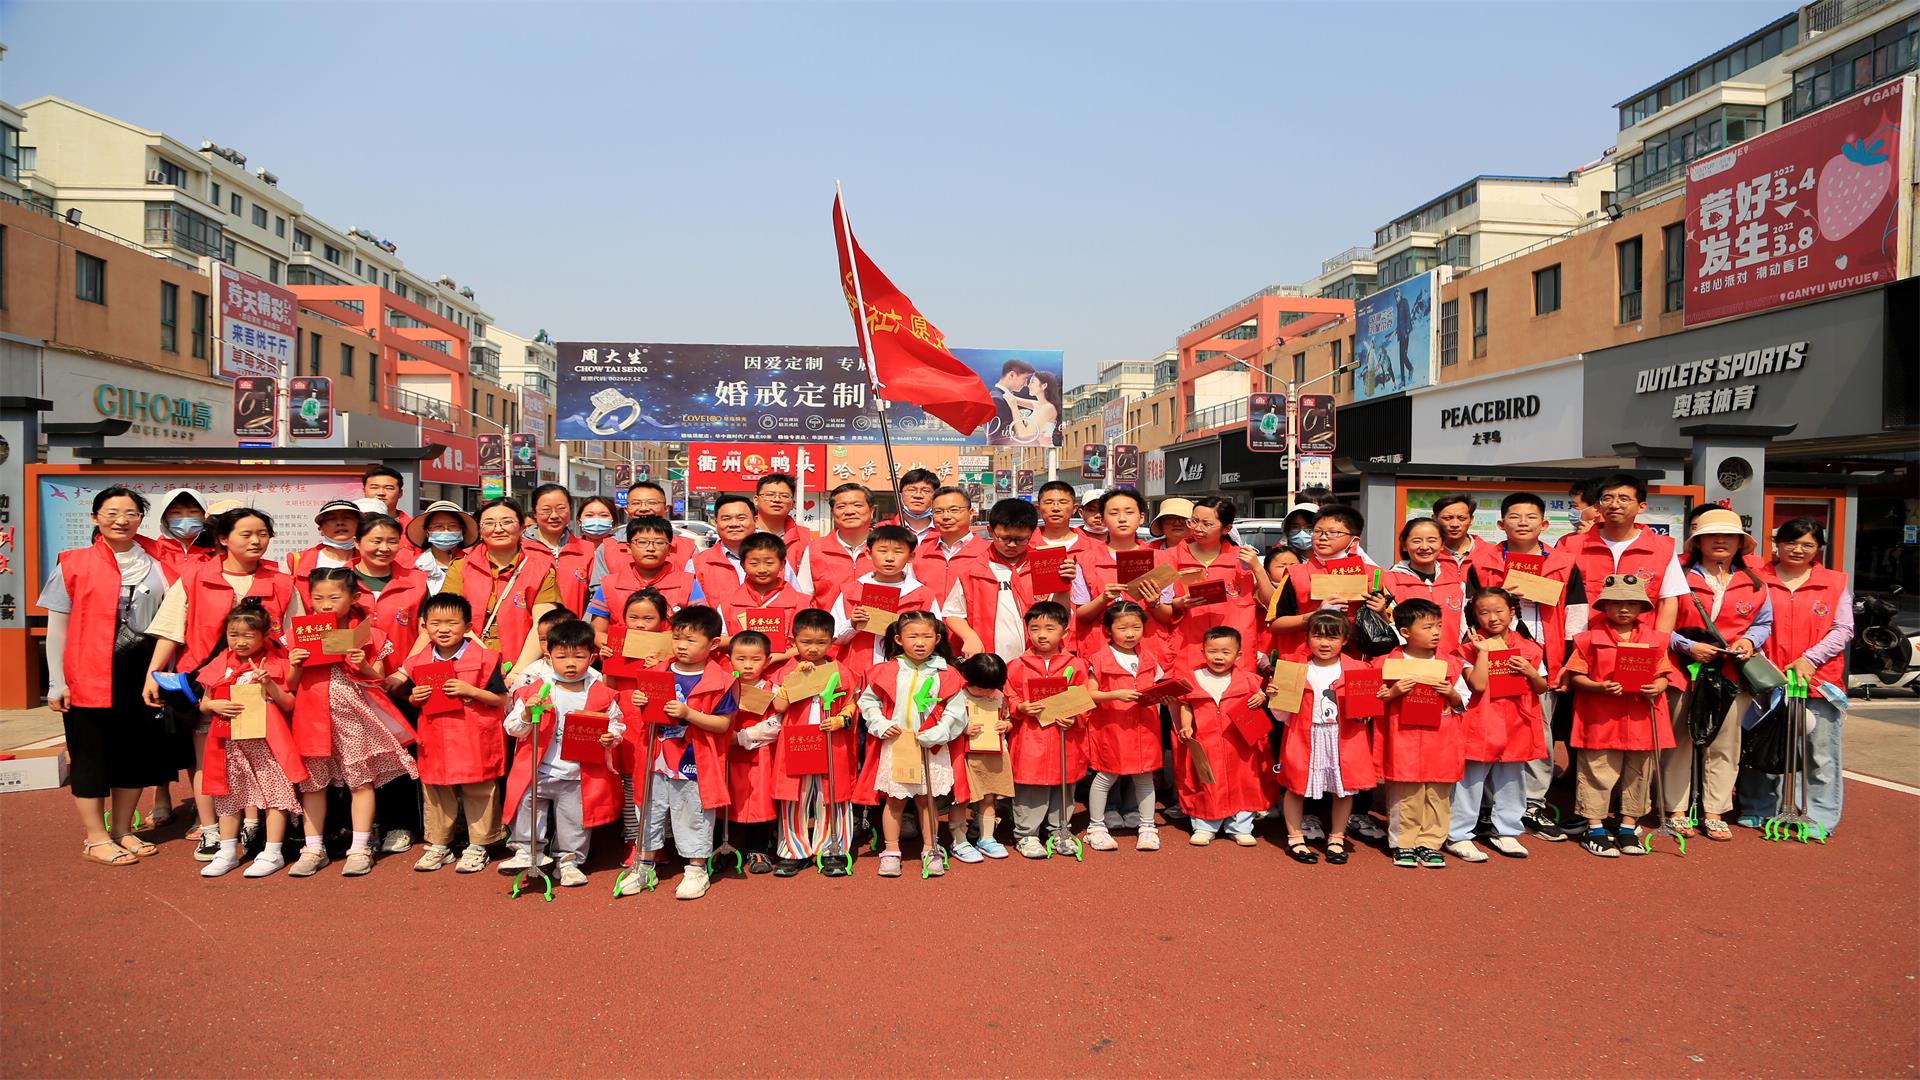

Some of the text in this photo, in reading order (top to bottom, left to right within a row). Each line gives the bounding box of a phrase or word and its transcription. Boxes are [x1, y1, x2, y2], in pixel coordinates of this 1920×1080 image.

[1774, 165, 1795, 178] 2022
[1774, 168, 1816, 201] 3.4
[1773, 222, 1794, 233] 2022
[1773, 226, 1814, 257] 3.8
[1699, 221, 1770, 279] 发生
[1700, 254, 1809, 294] 甜心派对 潮动春日
[1786, 272, 1873, 301] GANYU WUYUE
[232, 323, 288, 356] 来吾悦千斤
[232, 346, 281, 375] 草莓免费
[574, 365, 648, 373] CHOW TAI SENG
[580, 348, 642, 365] 周大生
[744, 356, 824, 371] 因爱定制
[1635, 341, 1807, 394] OUTLETS SPORTS
[94, 383, 173, 424] GIHO
[714, 380, 866, 409] 婚戒定制
[1672, 384, 1756, 418] 奥莱体育
[1441, 395, 1541, 430] PEACEBIRD
[697, 454, 742, 473] 衢州
